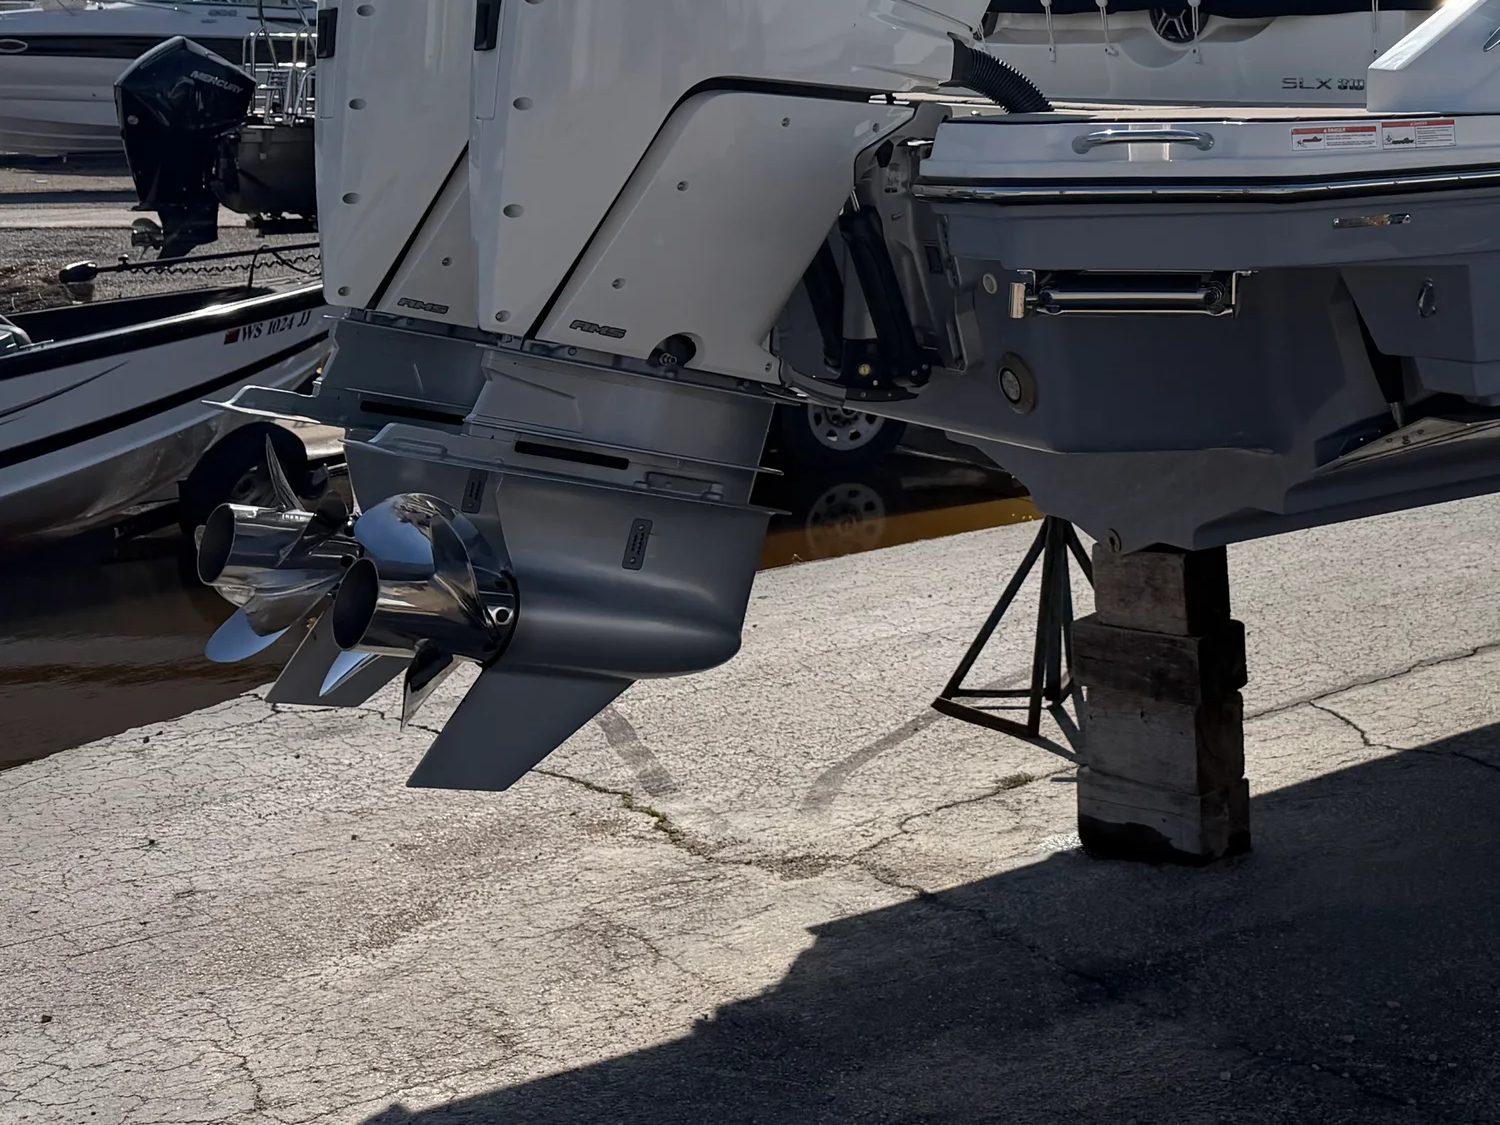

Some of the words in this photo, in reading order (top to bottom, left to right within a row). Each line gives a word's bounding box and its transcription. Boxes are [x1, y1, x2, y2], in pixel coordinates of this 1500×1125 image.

[190, 70, 244, 94] MERCURY
[1281, 77, 1333, 90] SLX
[242, 322, 264, 342] WS
[266, 314, 295, 336] 1024
[569, 319, 627, 339] AMS
